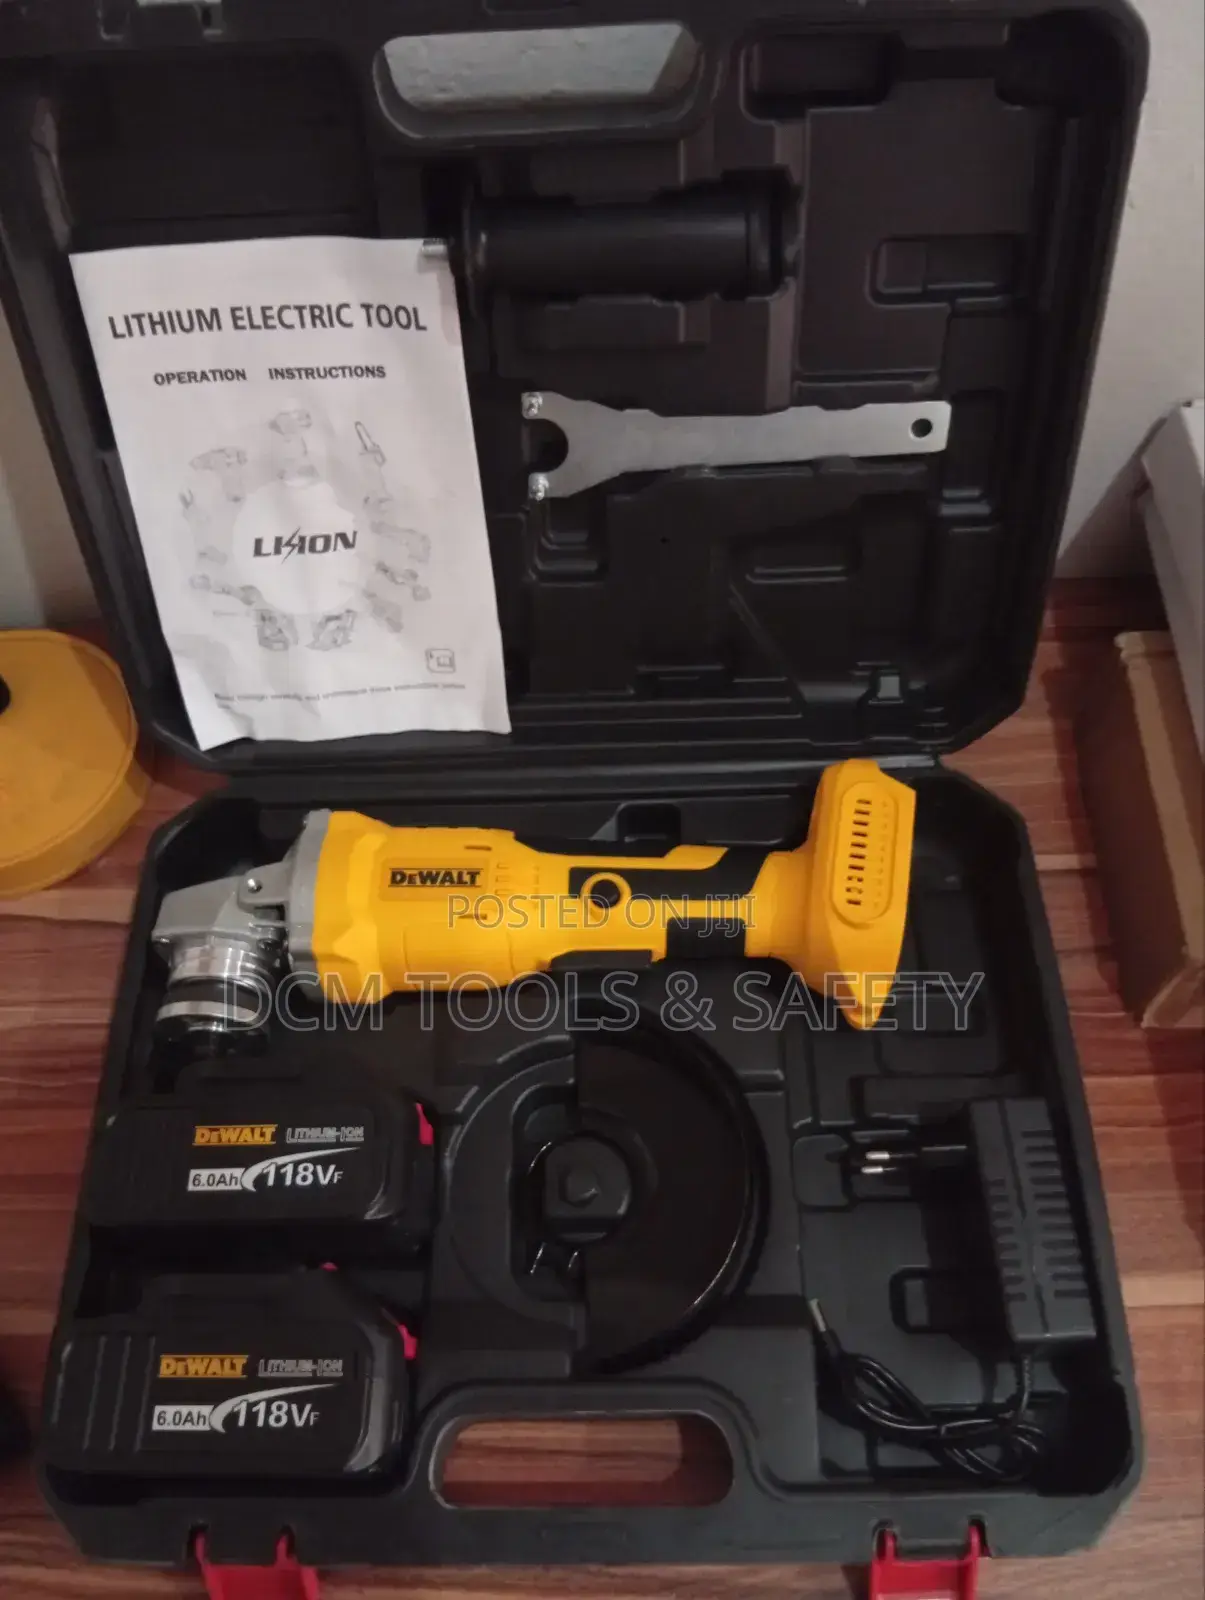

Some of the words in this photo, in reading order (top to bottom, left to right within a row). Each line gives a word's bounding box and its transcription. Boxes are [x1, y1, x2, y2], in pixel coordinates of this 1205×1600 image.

[108, 308, 222, 339] LITHIUM
[231, 303, 353, 331] ELECTRIC
[361, 303, 428, 332] TOOL
[153, 368, 248, 386] OPERATION
[268, 365, 387, 381] INSTRUCTIONS
[192, 1173, 239, 1187] 6.0Ah
[157, 1410, 207, 1426] 6.0Ah
